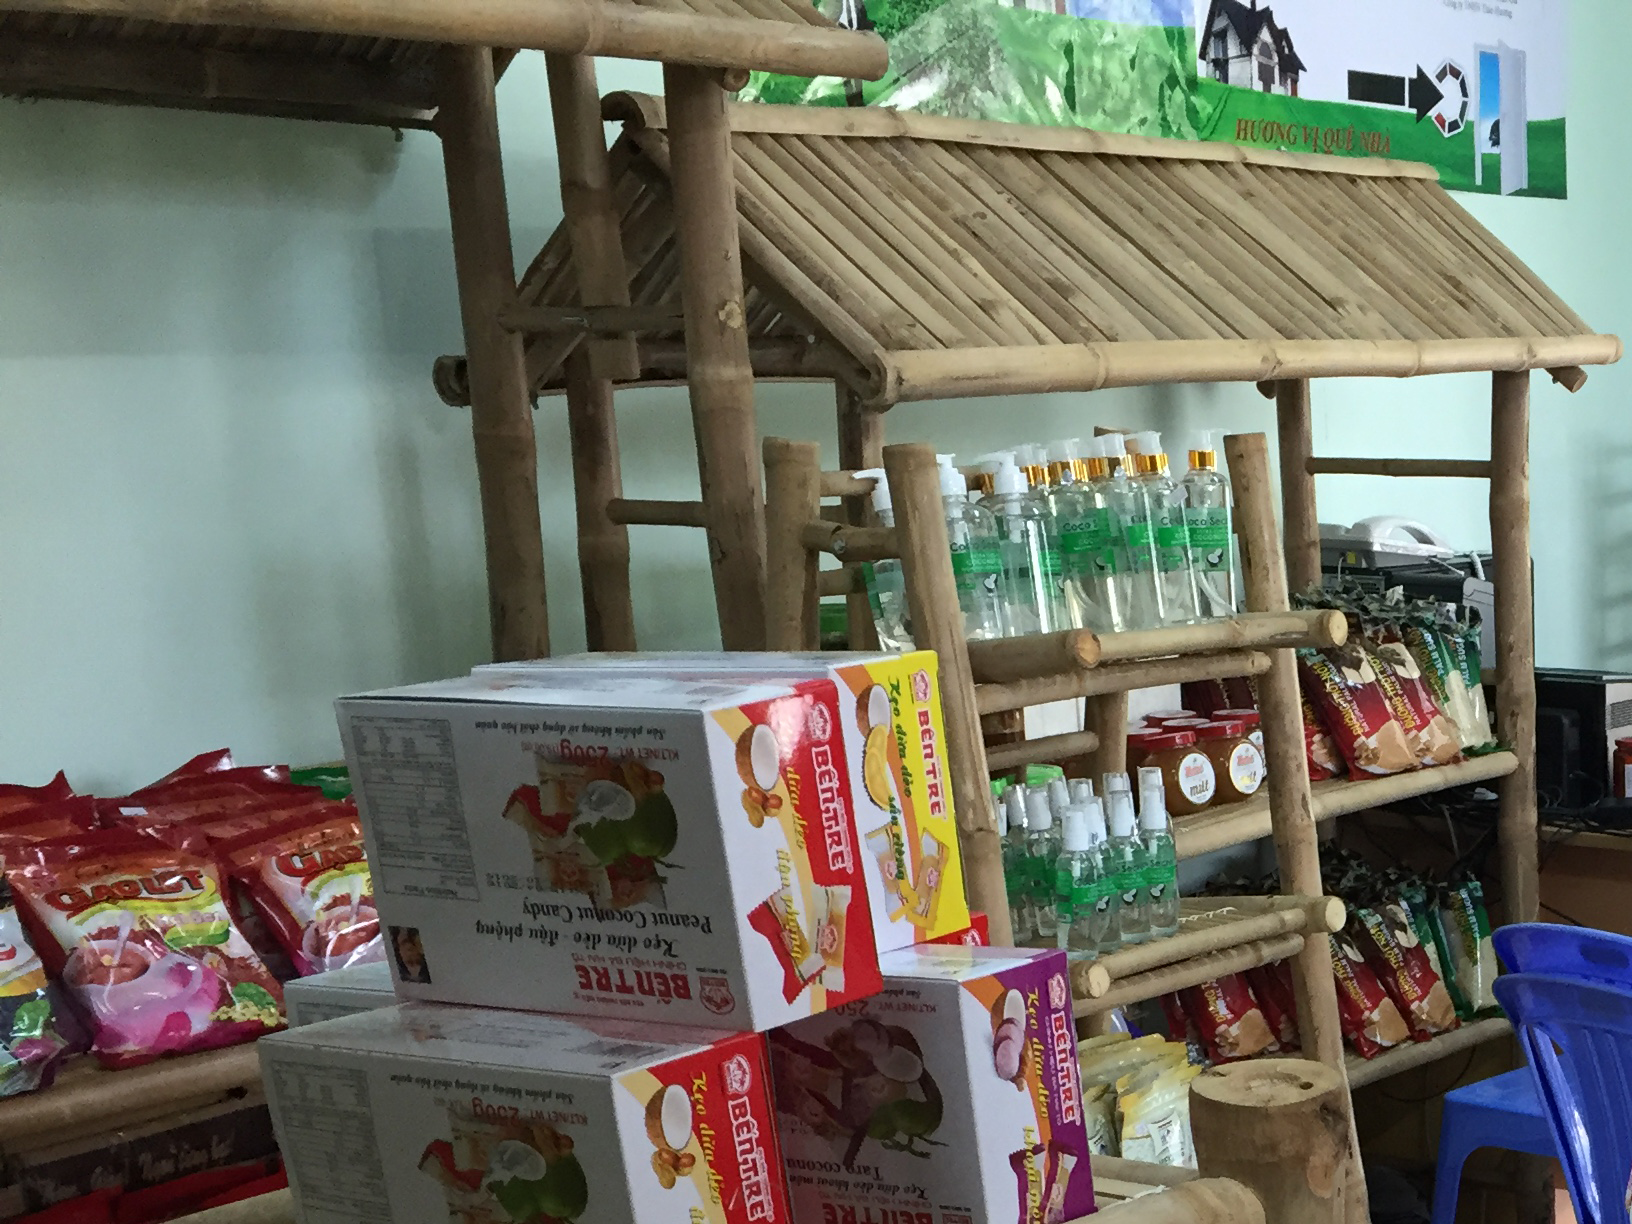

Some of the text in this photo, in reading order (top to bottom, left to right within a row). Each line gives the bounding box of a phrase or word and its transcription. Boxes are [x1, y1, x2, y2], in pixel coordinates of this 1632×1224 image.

[522, 896, 573, 922] Candy
[652, 912, 712, 934] Peanut
[786, 1159, 841, 1175] coconu
